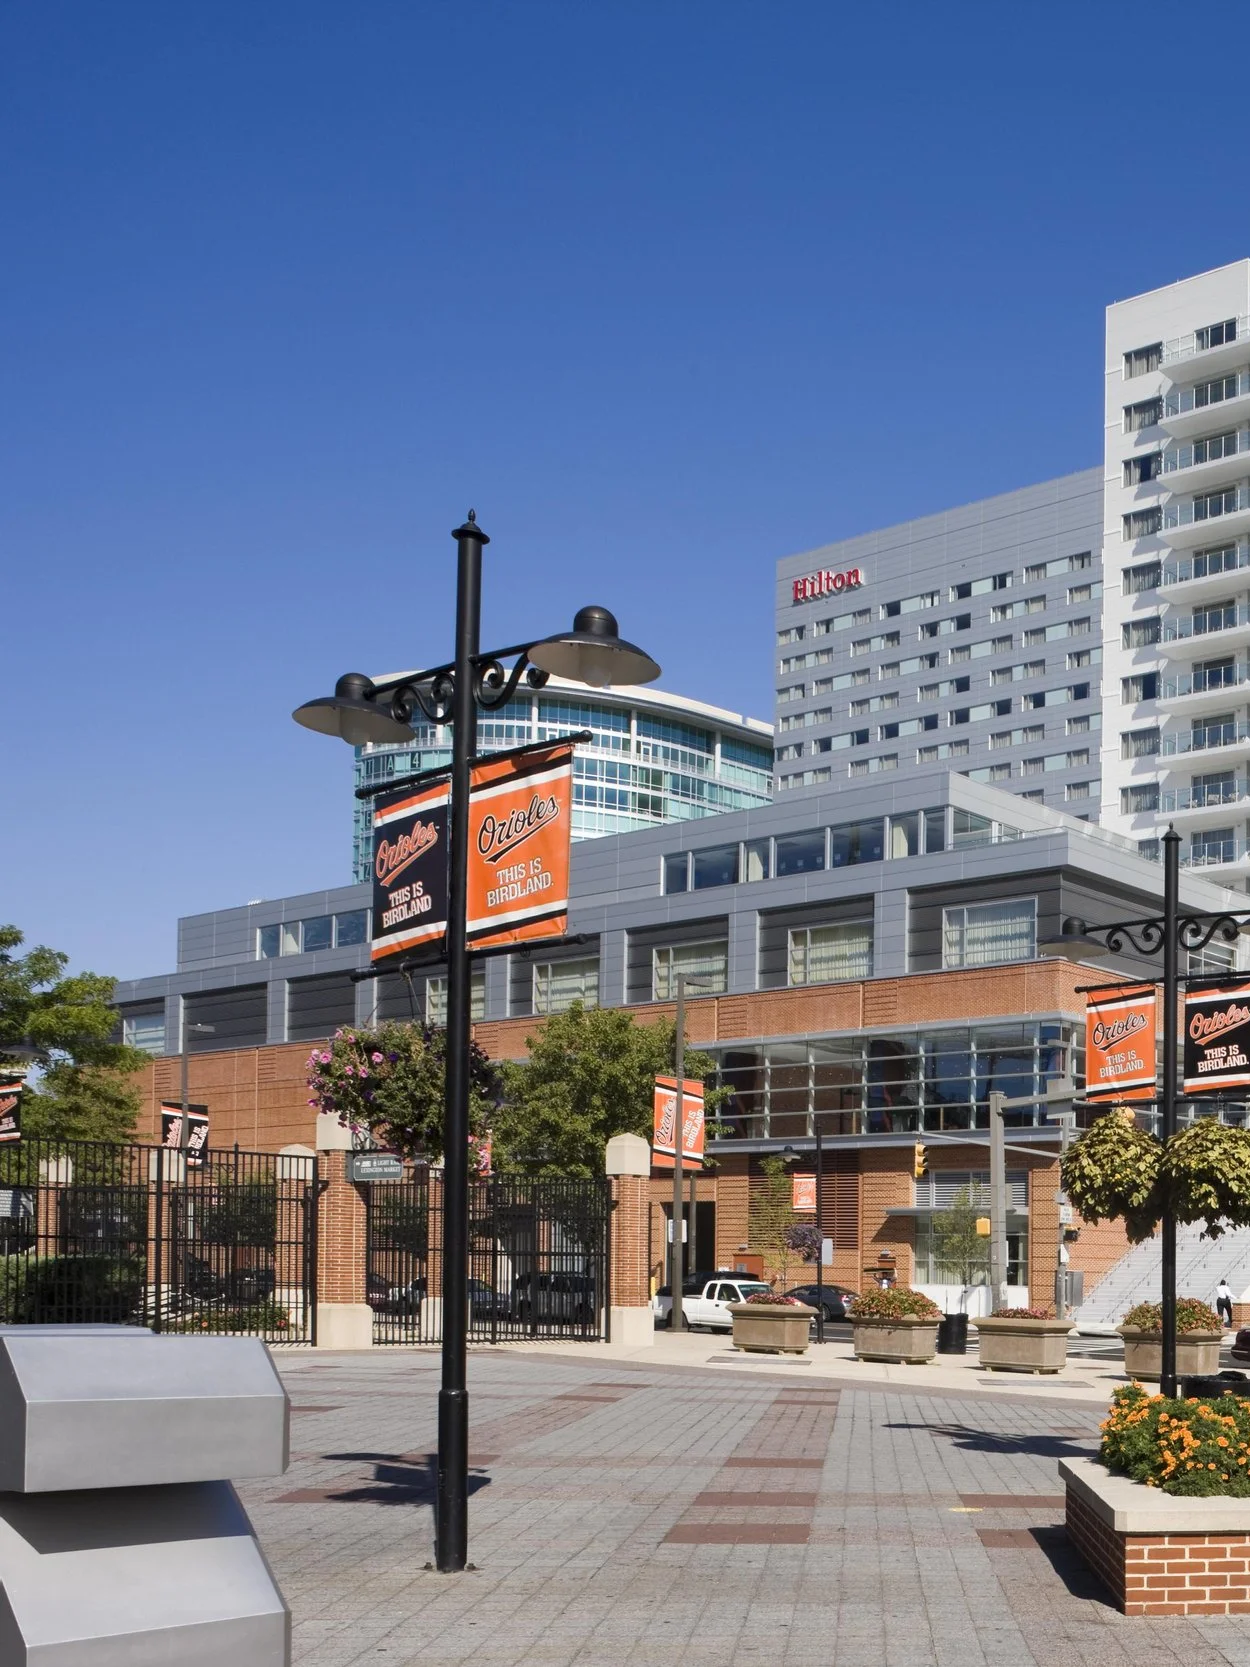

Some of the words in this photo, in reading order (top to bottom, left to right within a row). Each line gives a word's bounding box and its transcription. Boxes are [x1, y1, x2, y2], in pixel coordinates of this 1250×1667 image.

[793, 568, 863, 600] Hilton
[477, 794, 560, 855] Orioles
[376, 820, 439, 879] Orioles
[496, 863, 526, 885] THIS
[530, 858, 542, 877] IS
[388, 886, 411, 907] THIS
[412, 881, 424, 900] IS
[1092, 1012, 1149, 1046] Orioles
[1106, 1052, 1126, 1065] THIS
[1127, 1050, 1137, 1060] IS
[1197, 1054, 1250, 1073] BIRDLAND.
[1204, 1046, 1227, 1059] THIS
[1229, 1044, 1240, 1056] IS
